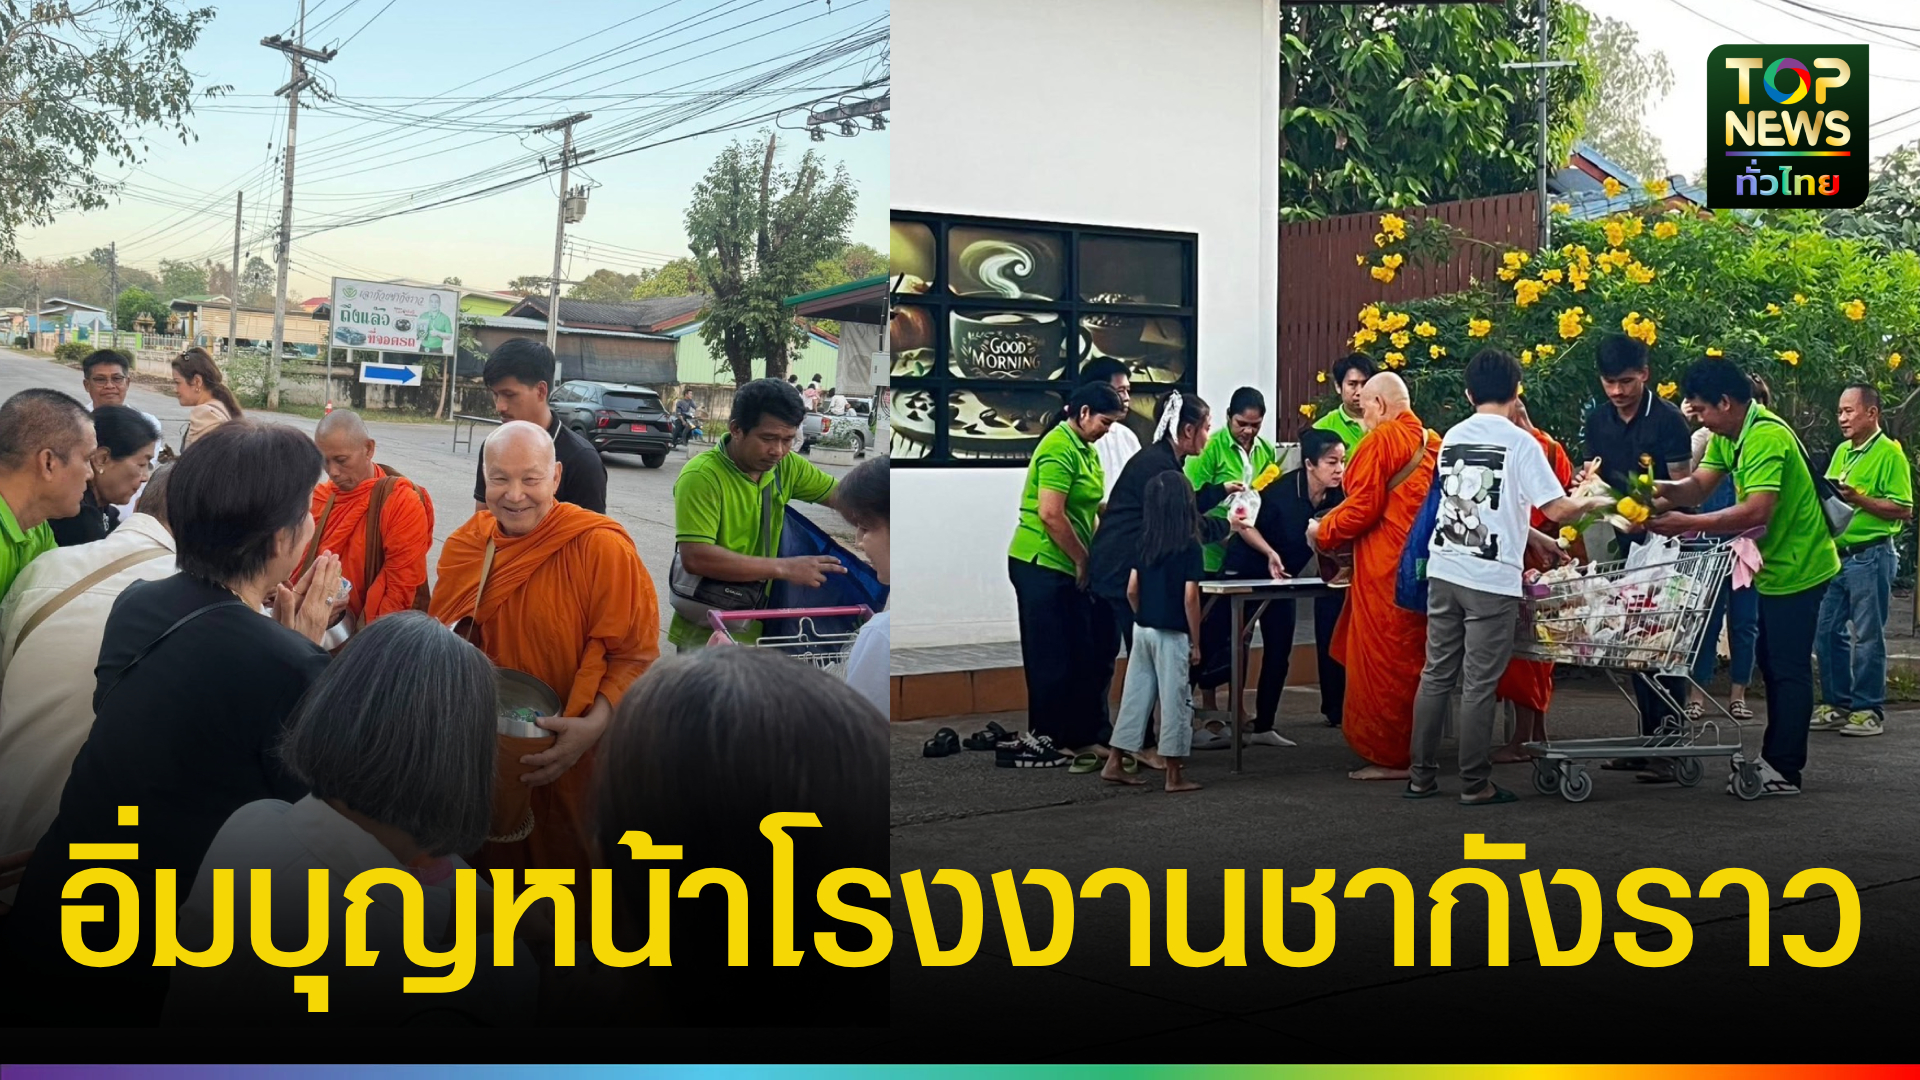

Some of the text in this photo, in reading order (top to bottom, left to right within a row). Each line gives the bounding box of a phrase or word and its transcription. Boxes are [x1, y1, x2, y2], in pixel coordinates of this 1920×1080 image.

[339, 303, 390, 326] ถึงแล้ว
[367, 328, 416, 347] ที่จอดรถ
[989, 337, 1027, 354] GOOD
[972, 350, 1041, 371] MORNING
